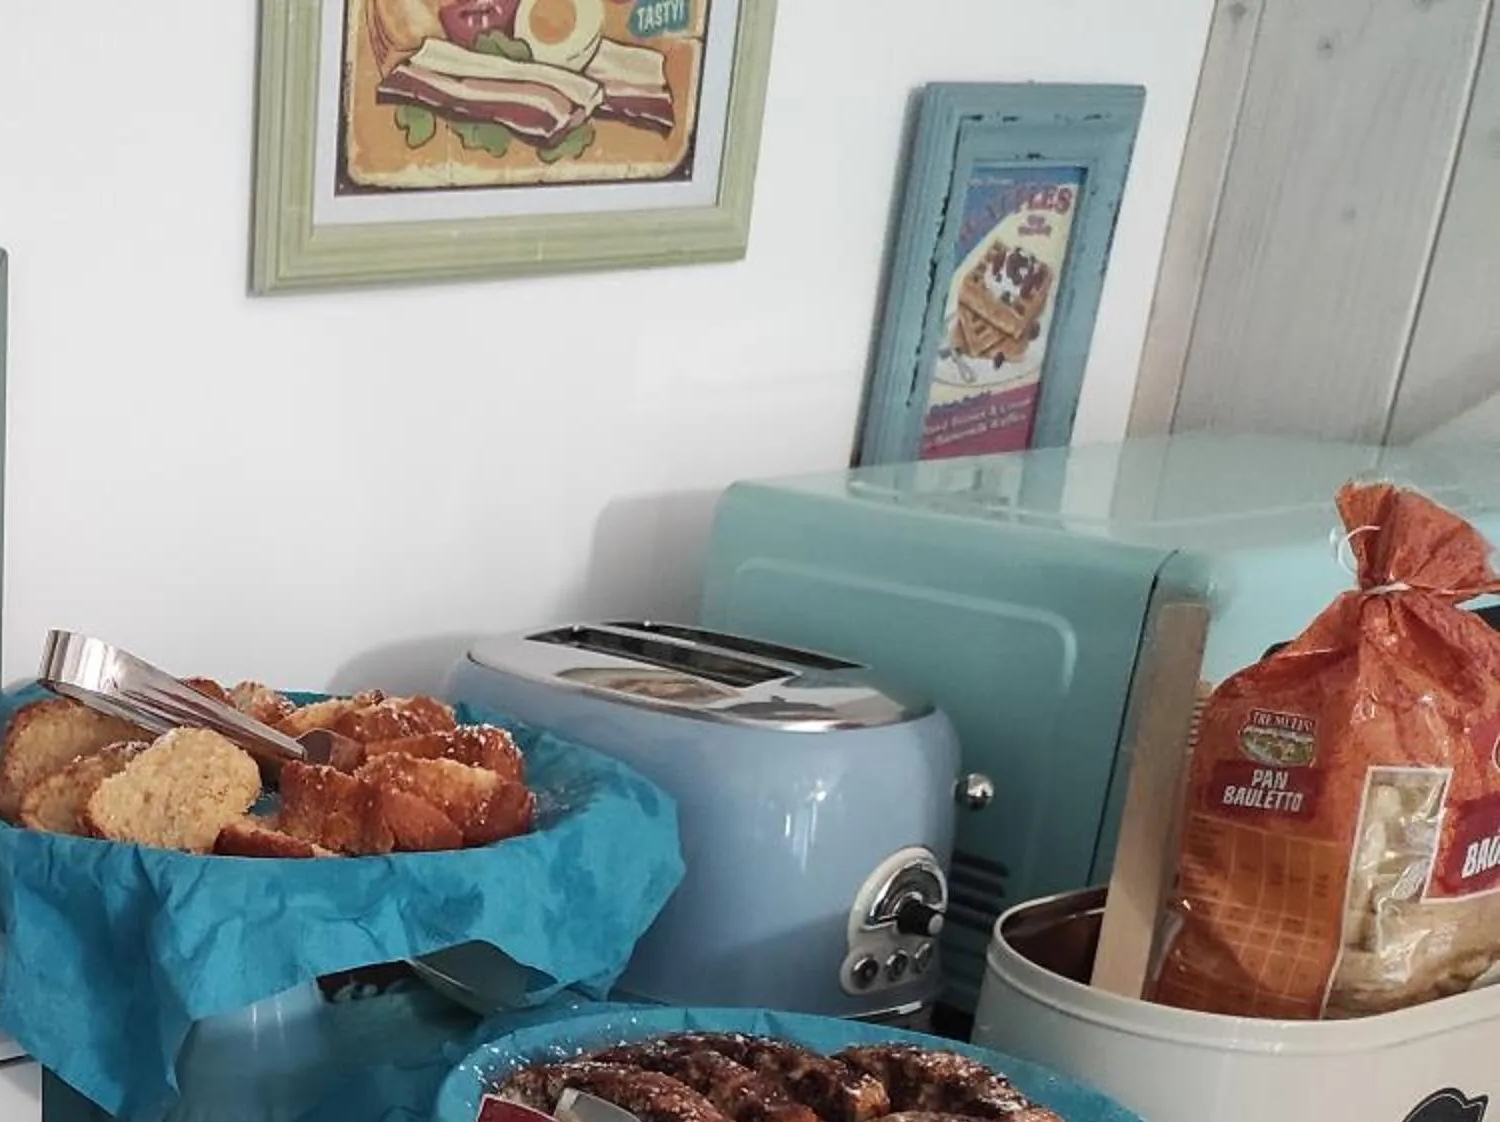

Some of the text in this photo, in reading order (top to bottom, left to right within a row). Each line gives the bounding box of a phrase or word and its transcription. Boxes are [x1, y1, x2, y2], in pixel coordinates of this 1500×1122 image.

[1251, 769, 1288, 790] PAN
[1223, 785, 1304, 812] BAULETTO
[1461, 835, 1500, 879] BAU
